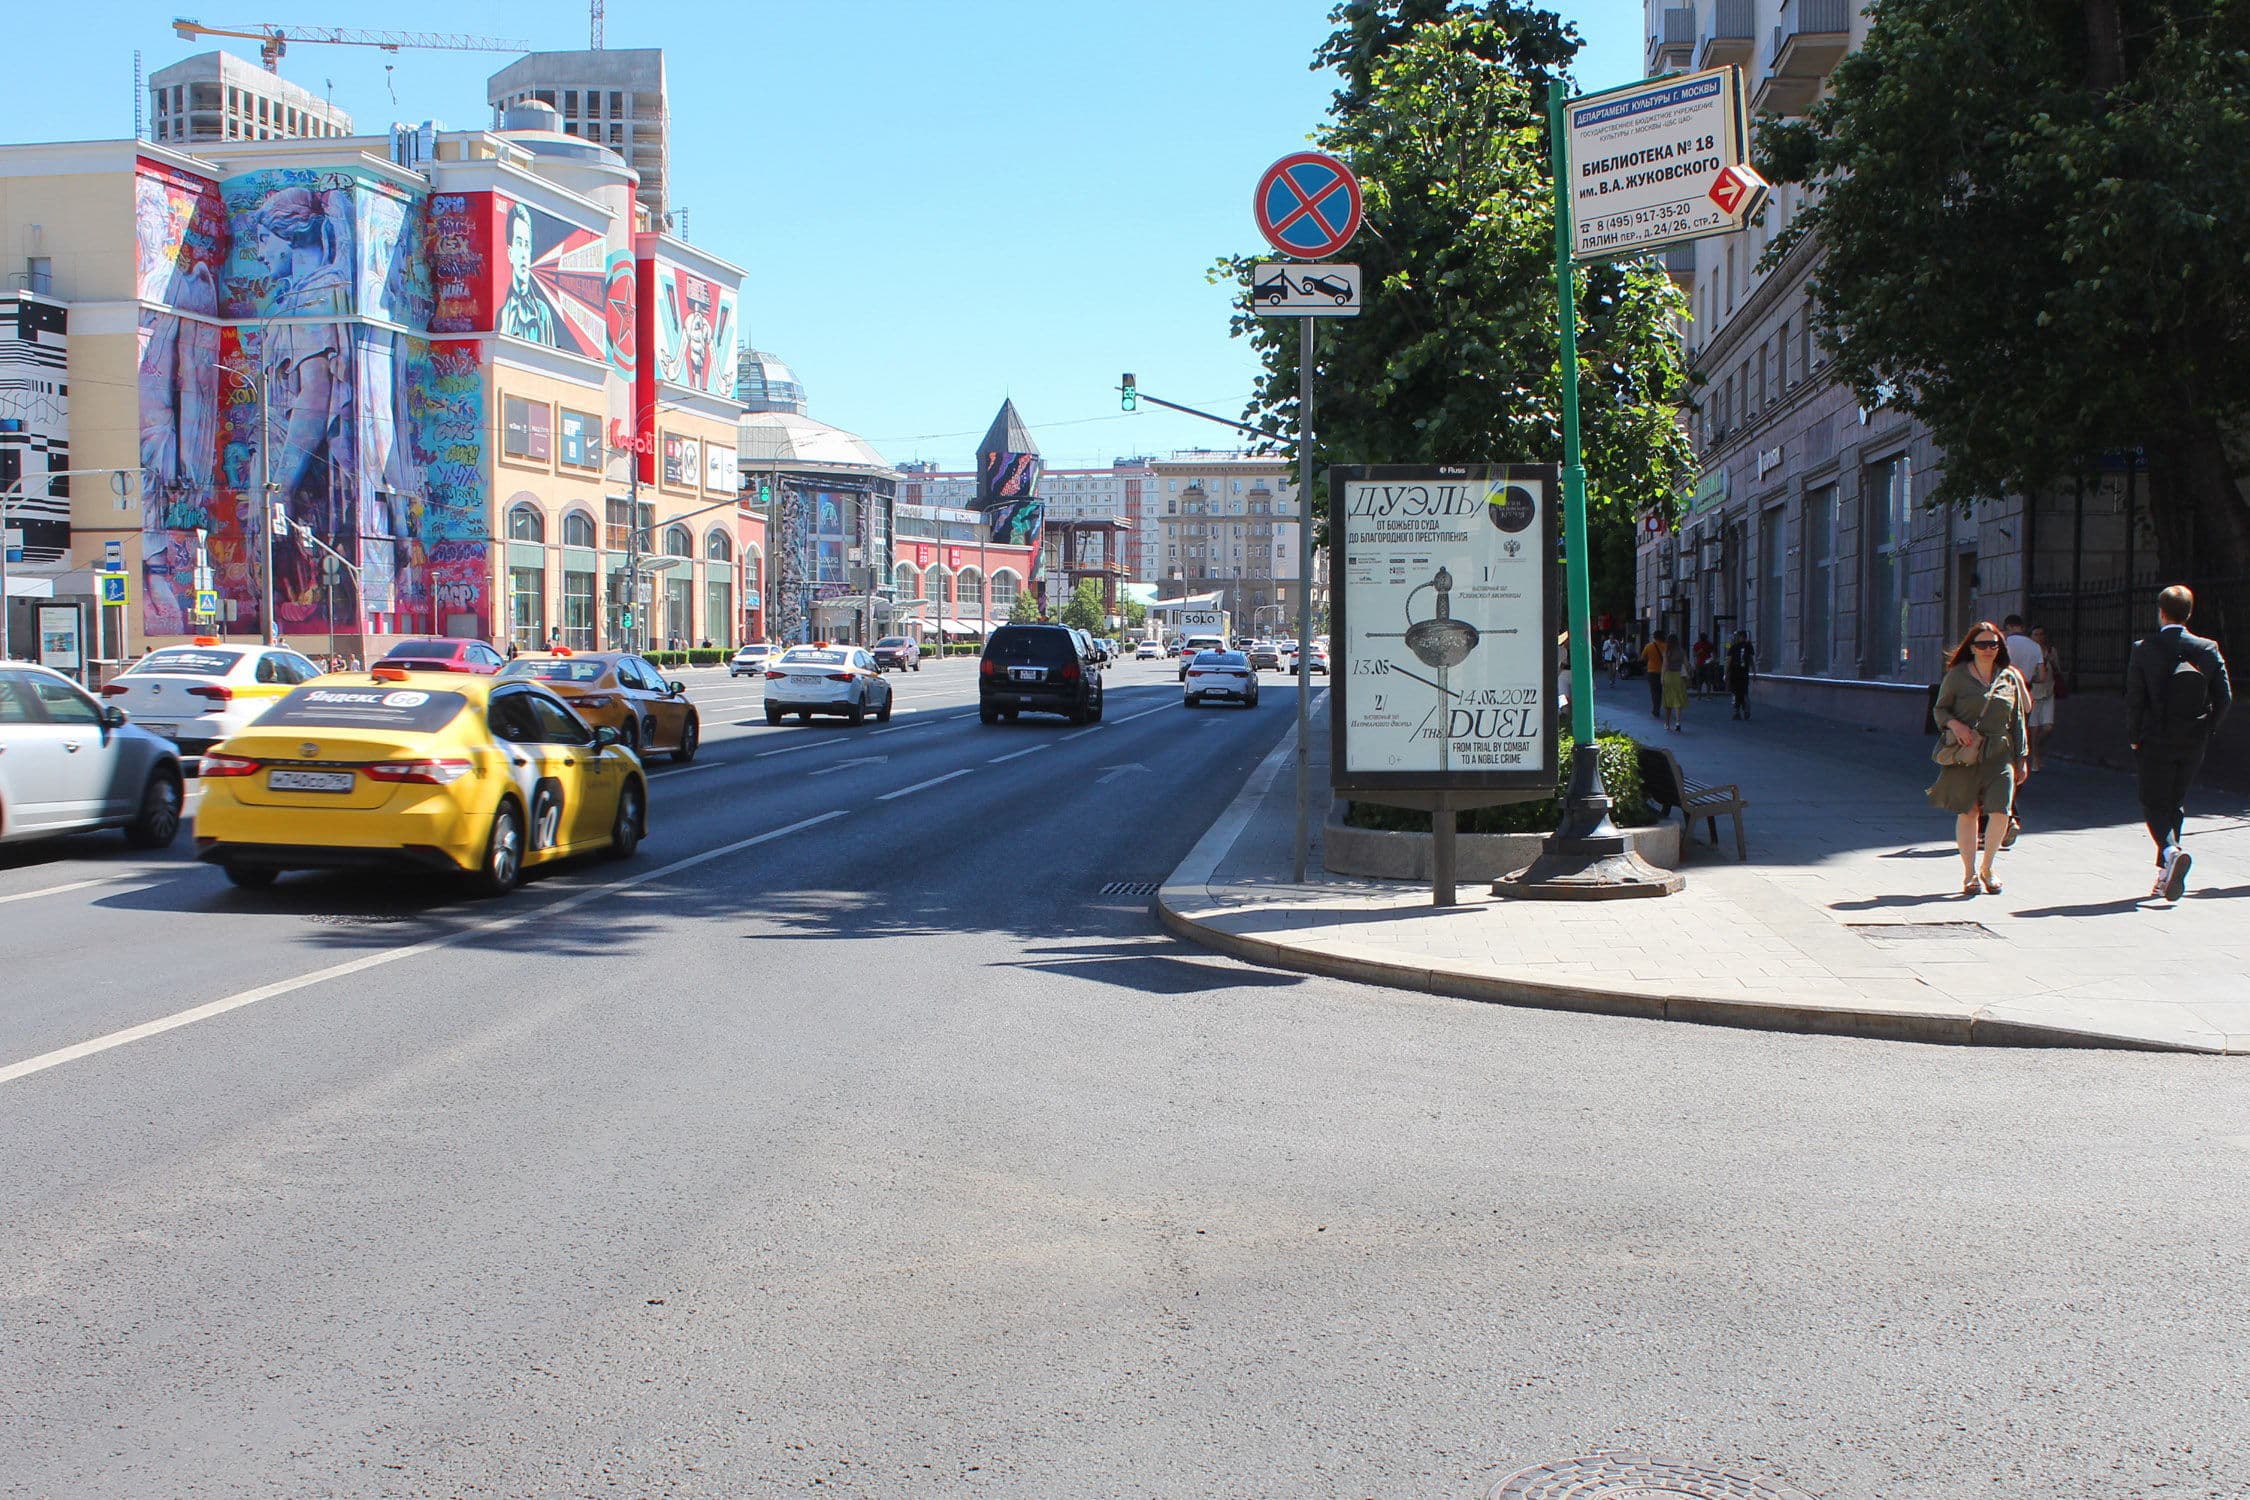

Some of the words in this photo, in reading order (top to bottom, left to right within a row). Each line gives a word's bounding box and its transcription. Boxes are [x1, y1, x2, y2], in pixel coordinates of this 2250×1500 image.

[1576, 104, 1630, 126] ДЕПАРТАМЕНТ
[1631, 93, 1670, 111] КУЛЬТУРЫ
[1673, 92, 1679, 101] Г.
[1681, 82, 1718, 99] МОСКВЫ
[1579, 120, 1634, 139] ГОСУДАРСТВЕННОЕ
[1634, 112, 1673, 127] БЮДЖЕТНОЕ
[1673, 101, 1714, 118] УЧРЕЖДЕНИЕ
[1582, 145, 1674, 178] БИБЛИОТЕКА
[1676, 139, 1692, 156] №
[1695, 135, 1714, 151] 18
[1579, 187, 1598, 199] им.
[1625, 157, 1720, 189] ЖУКОВСКОГО
[1597, 220, 1604, 231] 8
[1606, 215, 1634, 231] (495)
[1635, 203, 1691, 223] 917-35-20
[1581, 233, 1618, 249] ЛЯЛИН
[1376, 520, 1385, 530] ОТ
[1387, 519, 1420, 530] БОЖЬЕГО
[1421, 519, 1440, 530] СУДА
[1348, 533, 1359, 544] ДО
[1360, 532, 1414, 543] БЛАГОРОДНОГО
[1415, 531, 1468, 542] ПРЕСТУПЛЕНИЯ
[1185, 615, 1215, 624] SOLO
[1352, 659, 1390, 675] 13.05
[303, 690, 383, 703] Яндекс
[1457, 688, 1537, 706] 14.08.2022
[1447, 708, 1538, 739] DUEL
[1452, 742, 1472, 752] FROM
[1473, 742, 1491, 752] TRIAL
[1493, 742, 1502, 752] BY
[1503, 741, 1530, 752] COMBAT
[1461, 754, 1469, 764] TO
[1471, 754, 1478, 764] A
[1478, 754, 1499, 764] NOBLE
[1500, 753, 1522, 764] CRIME
